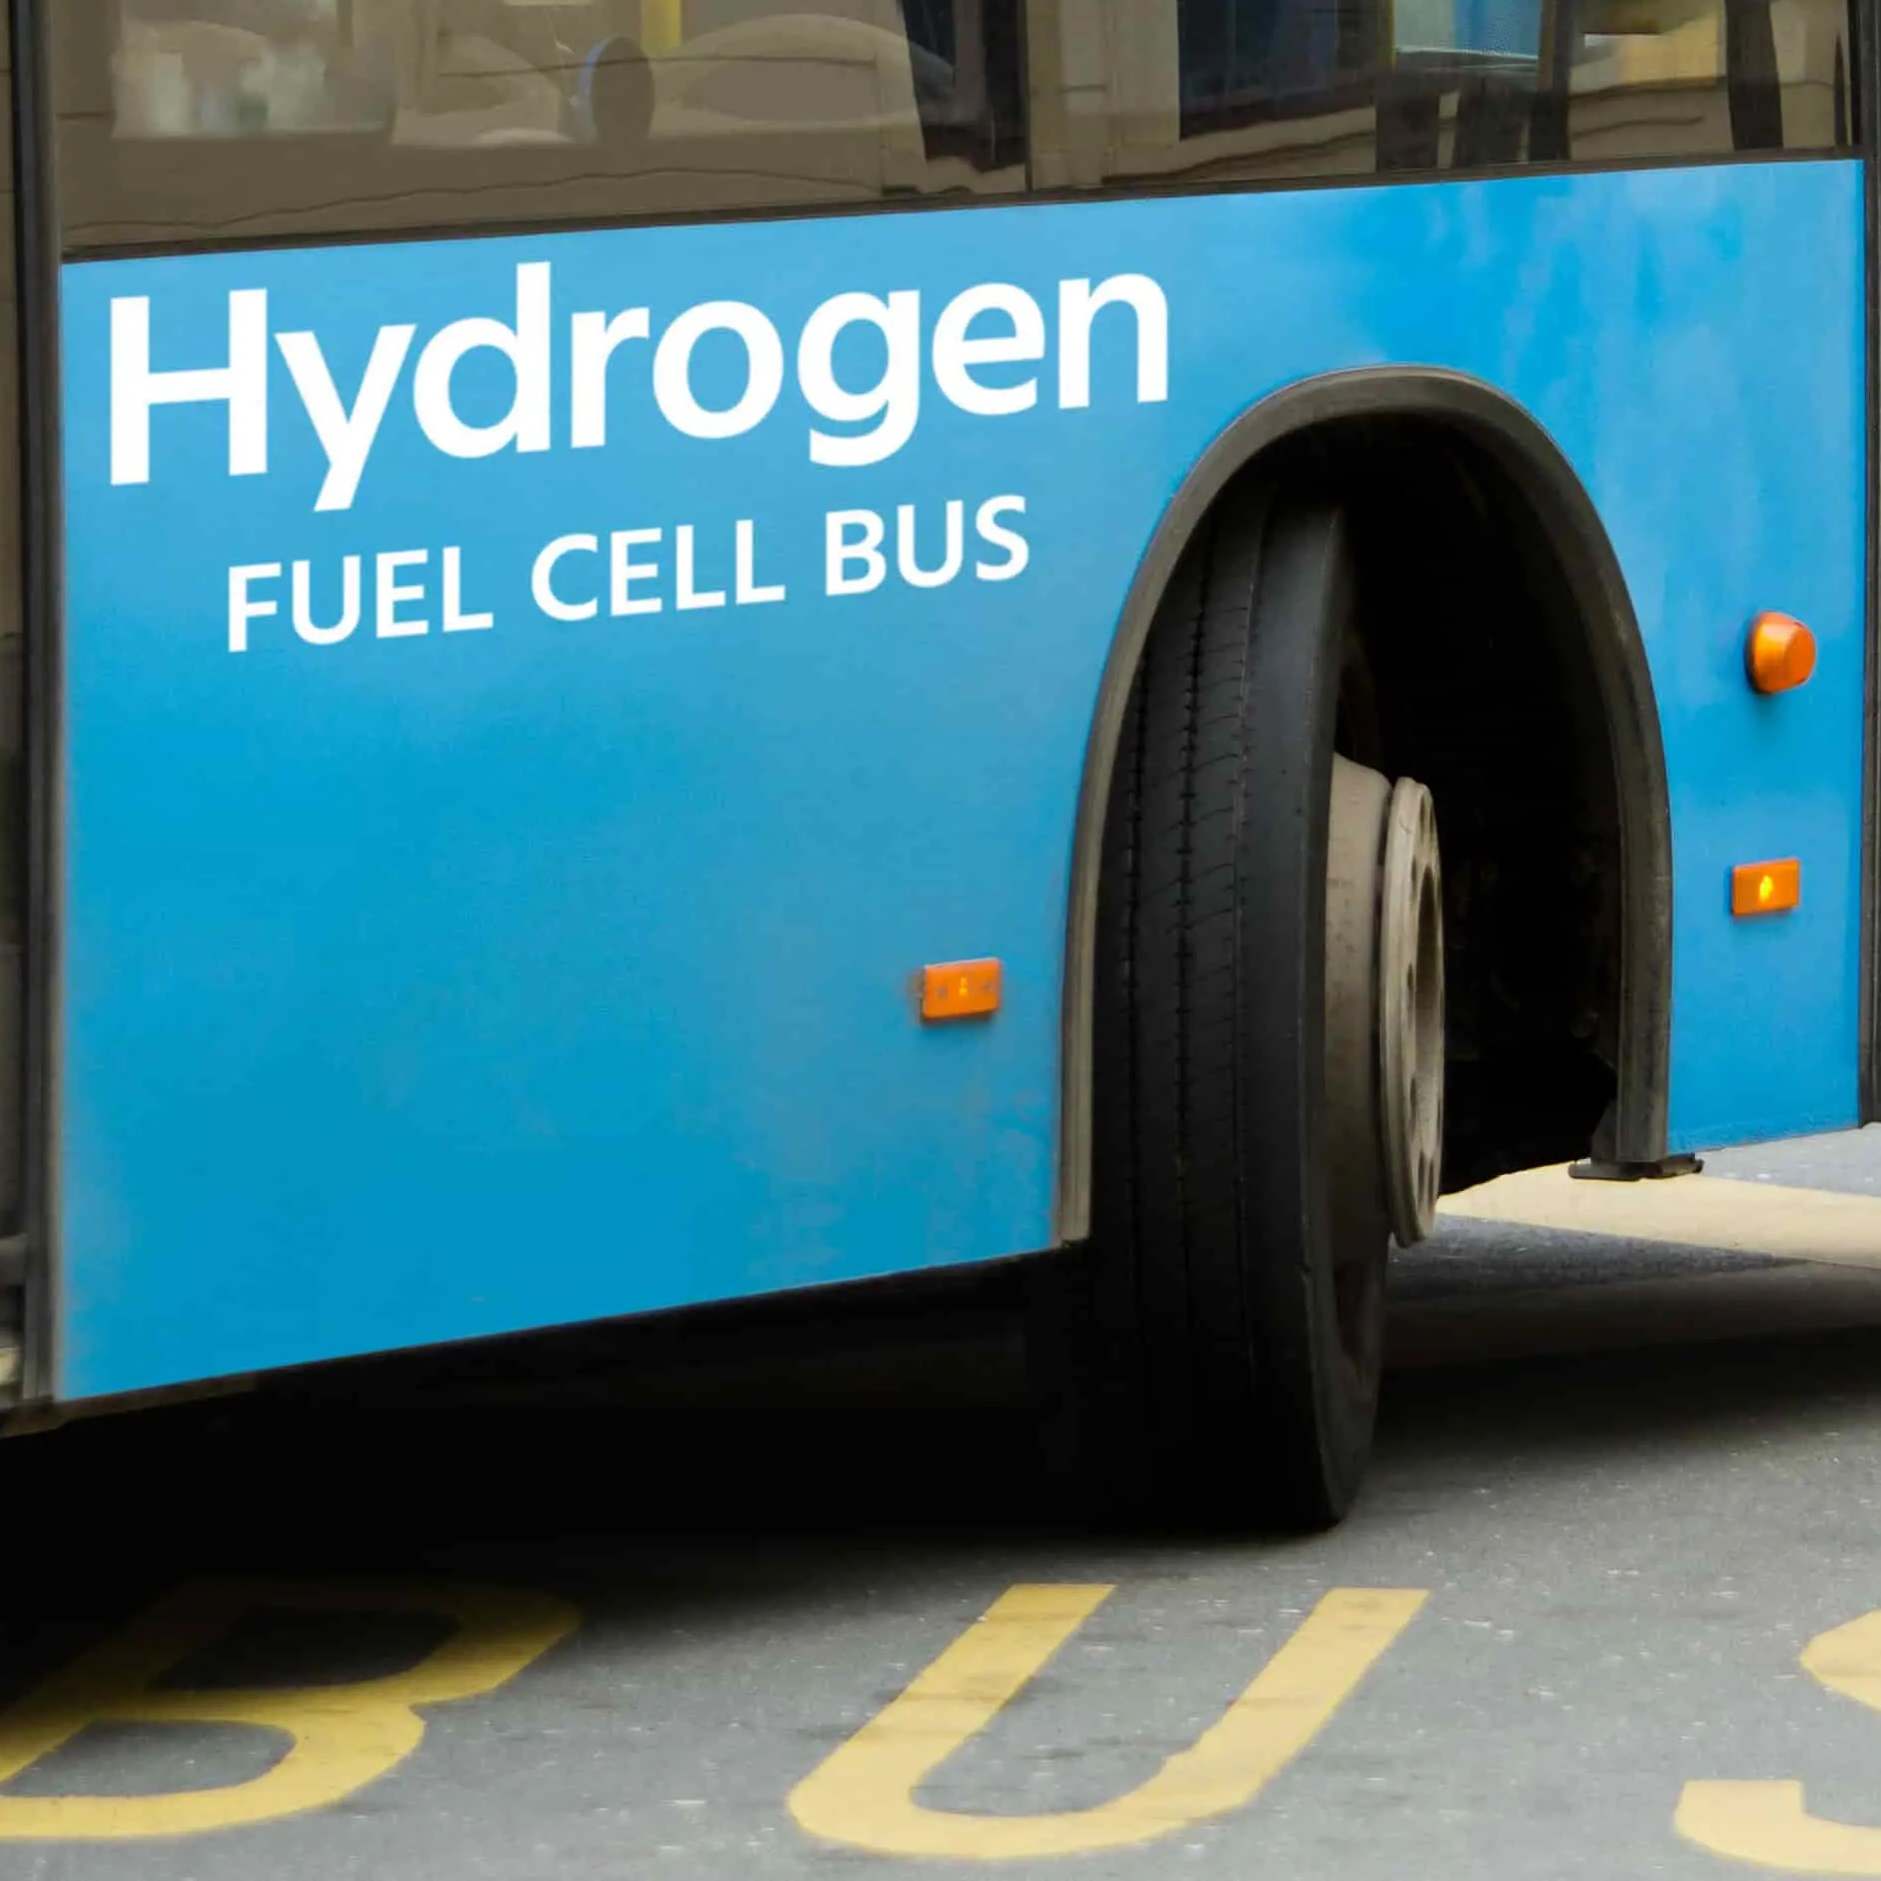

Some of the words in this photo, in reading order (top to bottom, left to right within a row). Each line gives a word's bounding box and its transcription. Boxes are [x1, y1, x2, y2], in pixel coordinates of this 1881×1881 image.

[107, 260, 1170, 512] Hydrogen
[227, 545, 494, 654] FUEL
[531, 518, 787, 621] CELL
[824, 493, 1031, 597] BUS
